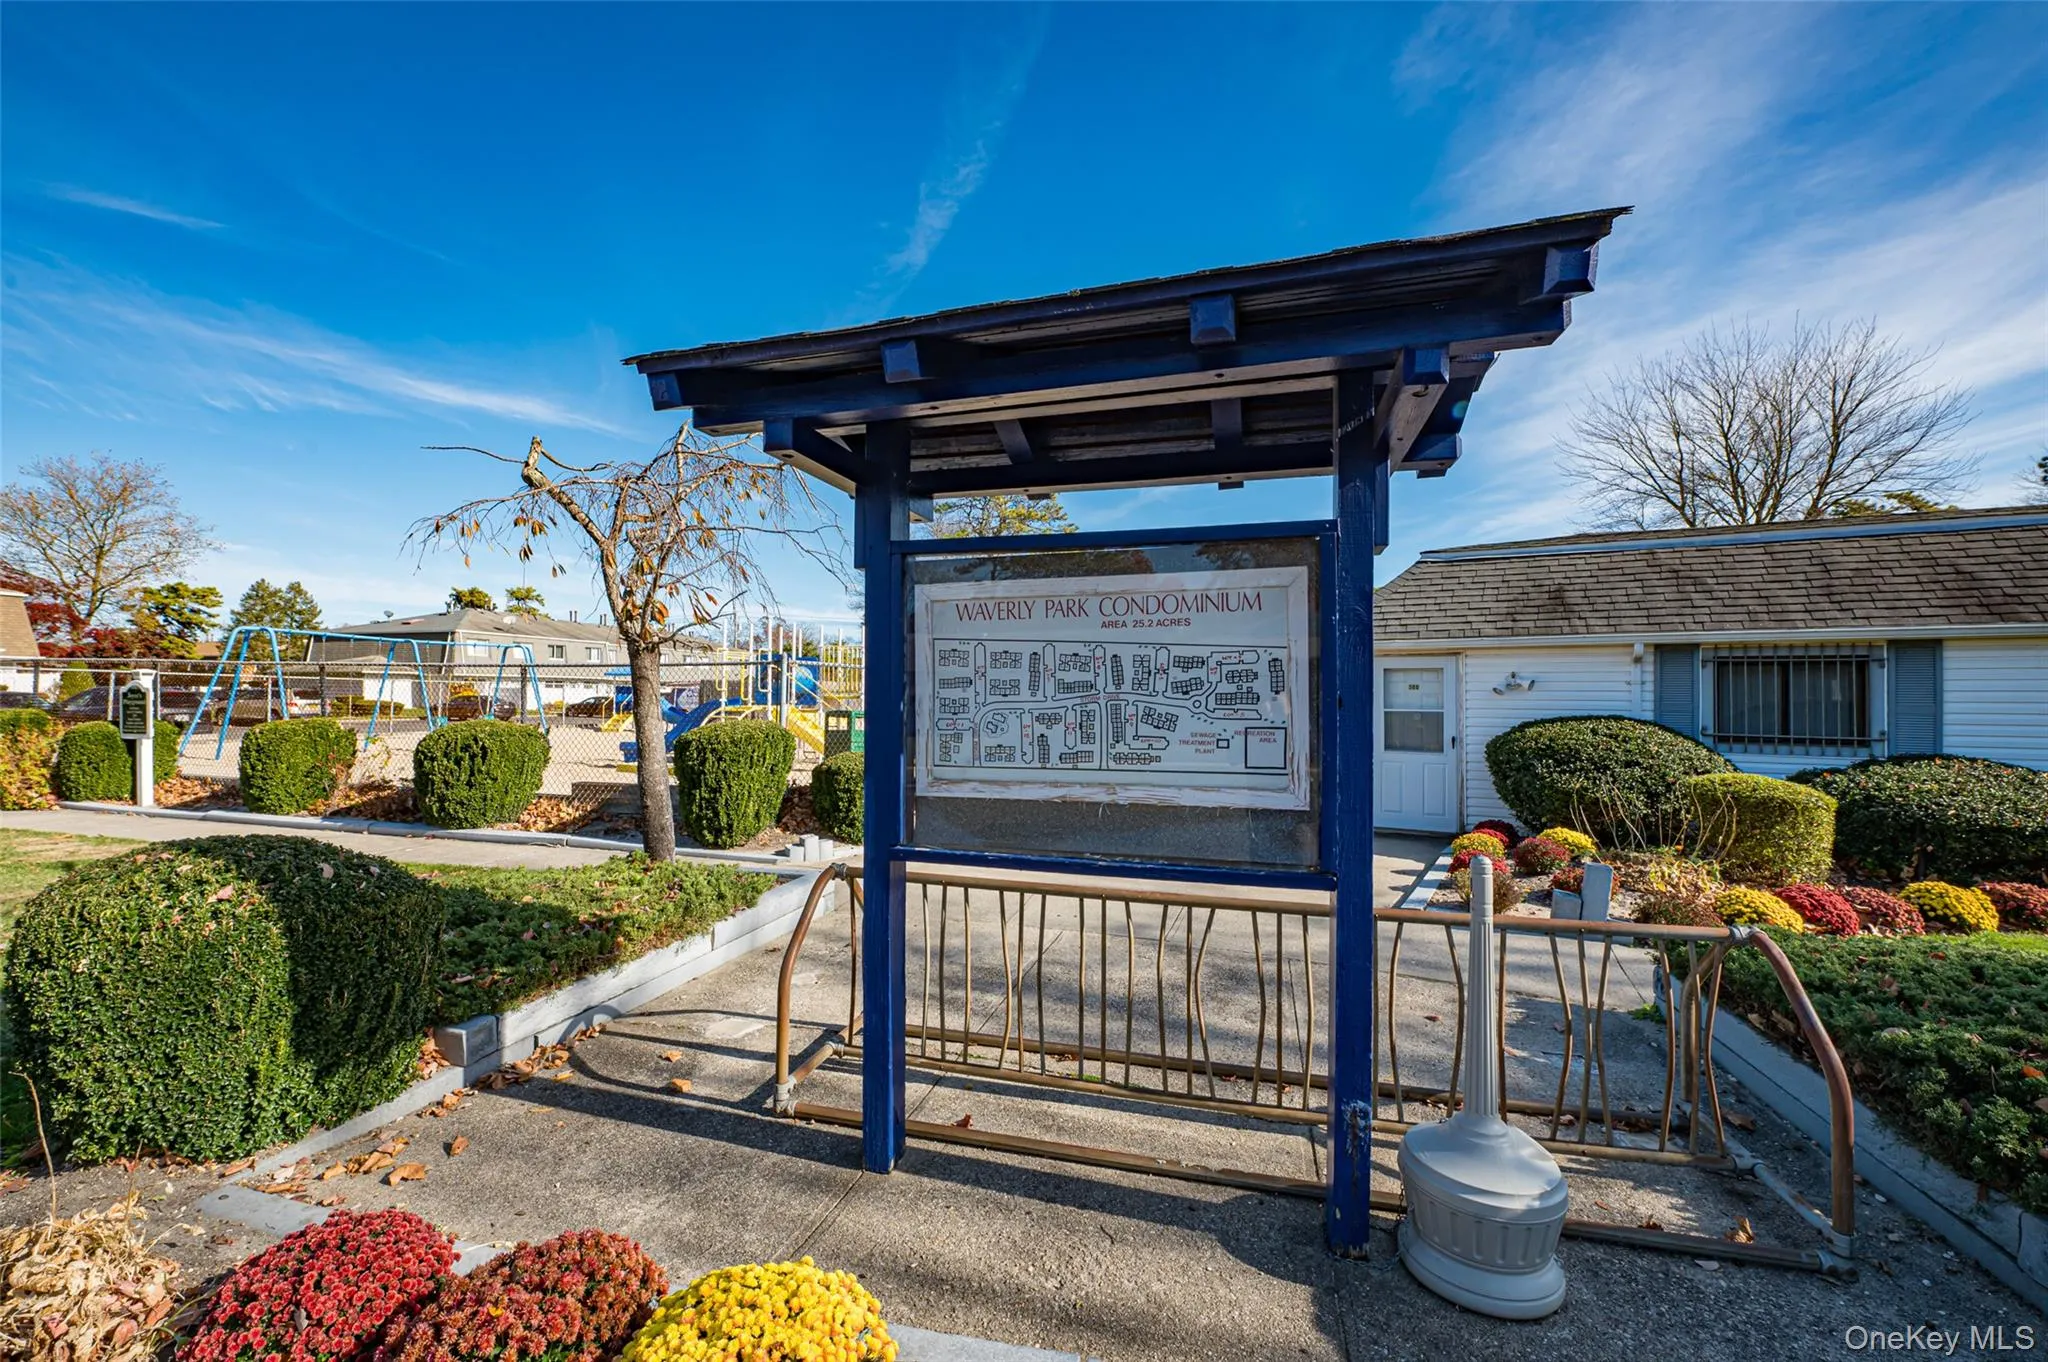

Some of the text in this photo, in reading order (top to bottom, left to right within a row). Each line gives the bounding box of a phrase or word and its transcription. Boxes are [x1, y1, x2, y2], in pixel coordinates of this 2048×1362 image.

[955, 591, 1263, 621] WAVERLY PARK CONDOMINIUM
[1100, 617, 1192, 629] AREA 25.2 ACRES
